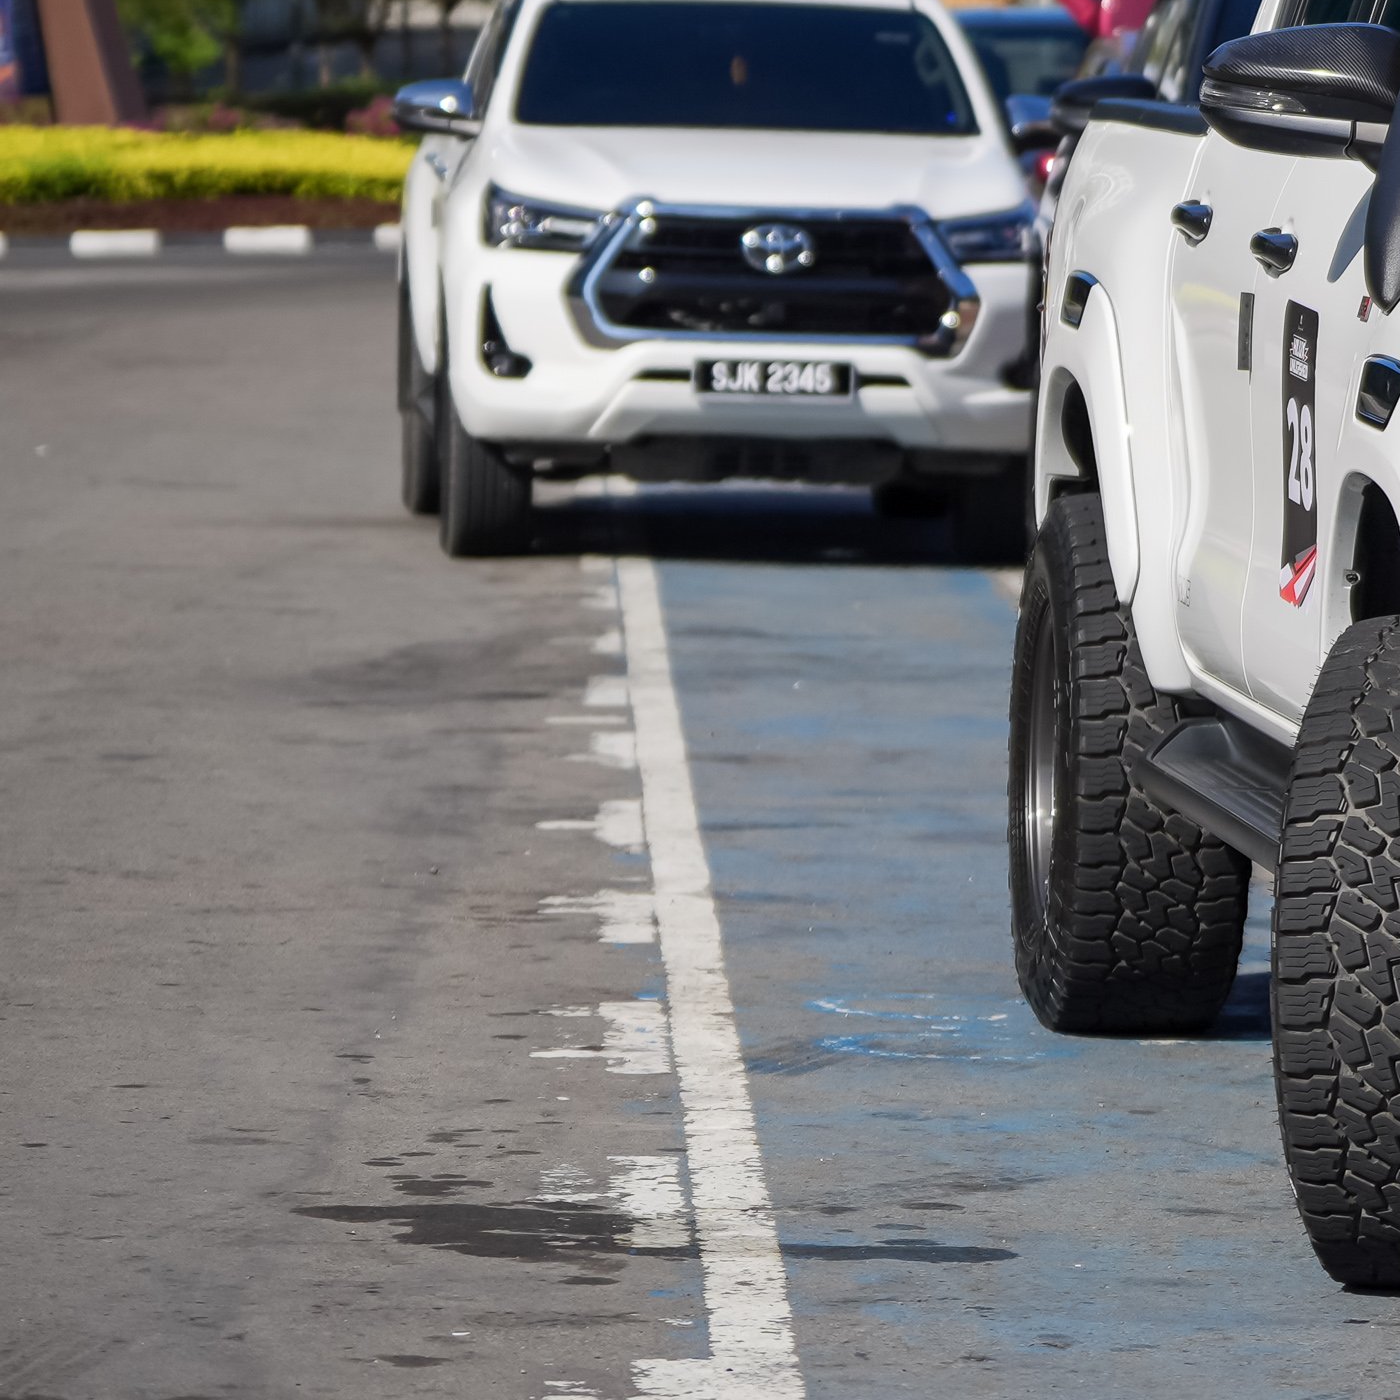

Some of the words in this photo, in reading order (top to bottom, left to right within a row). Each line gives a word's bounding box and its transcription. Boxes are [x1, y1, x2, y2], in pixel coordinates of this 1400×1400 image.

[712, 361, 760, 392] SJK
[767, 362, 832, 394] 2345
[1287, 397, 1313, 511] 28
